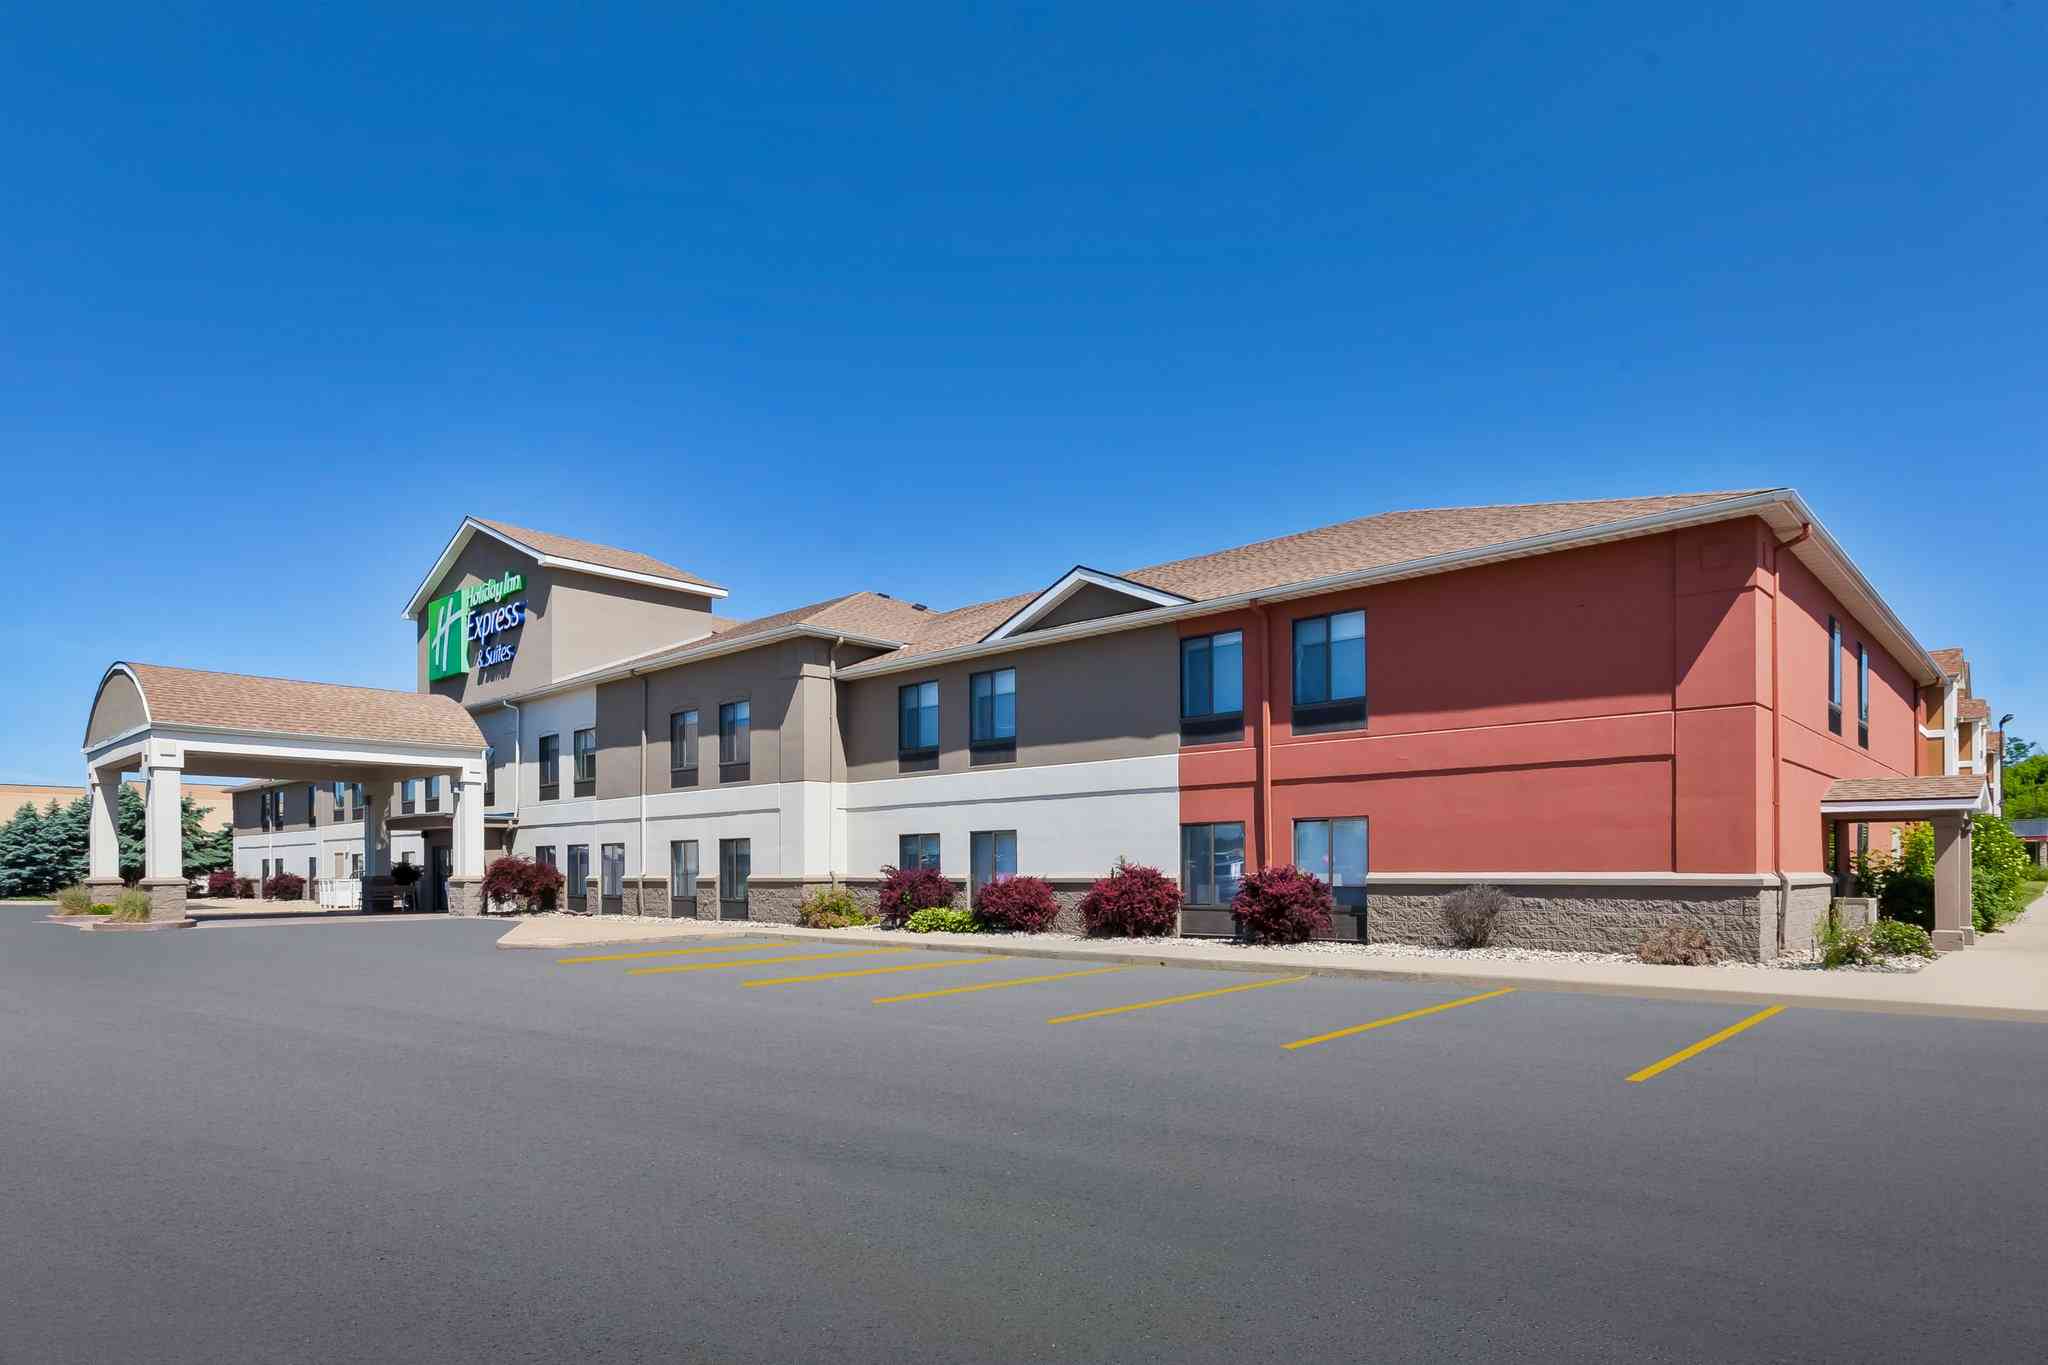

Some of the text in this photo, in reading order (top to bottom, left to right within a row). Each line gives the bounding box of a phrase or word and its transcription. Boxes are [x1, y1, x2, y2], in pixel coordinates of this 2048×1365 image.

[467, 571, 523, 607] Holiday Inn
[467, 601, 520, 645] Express
[477, 643, 512, 667] & Suites
